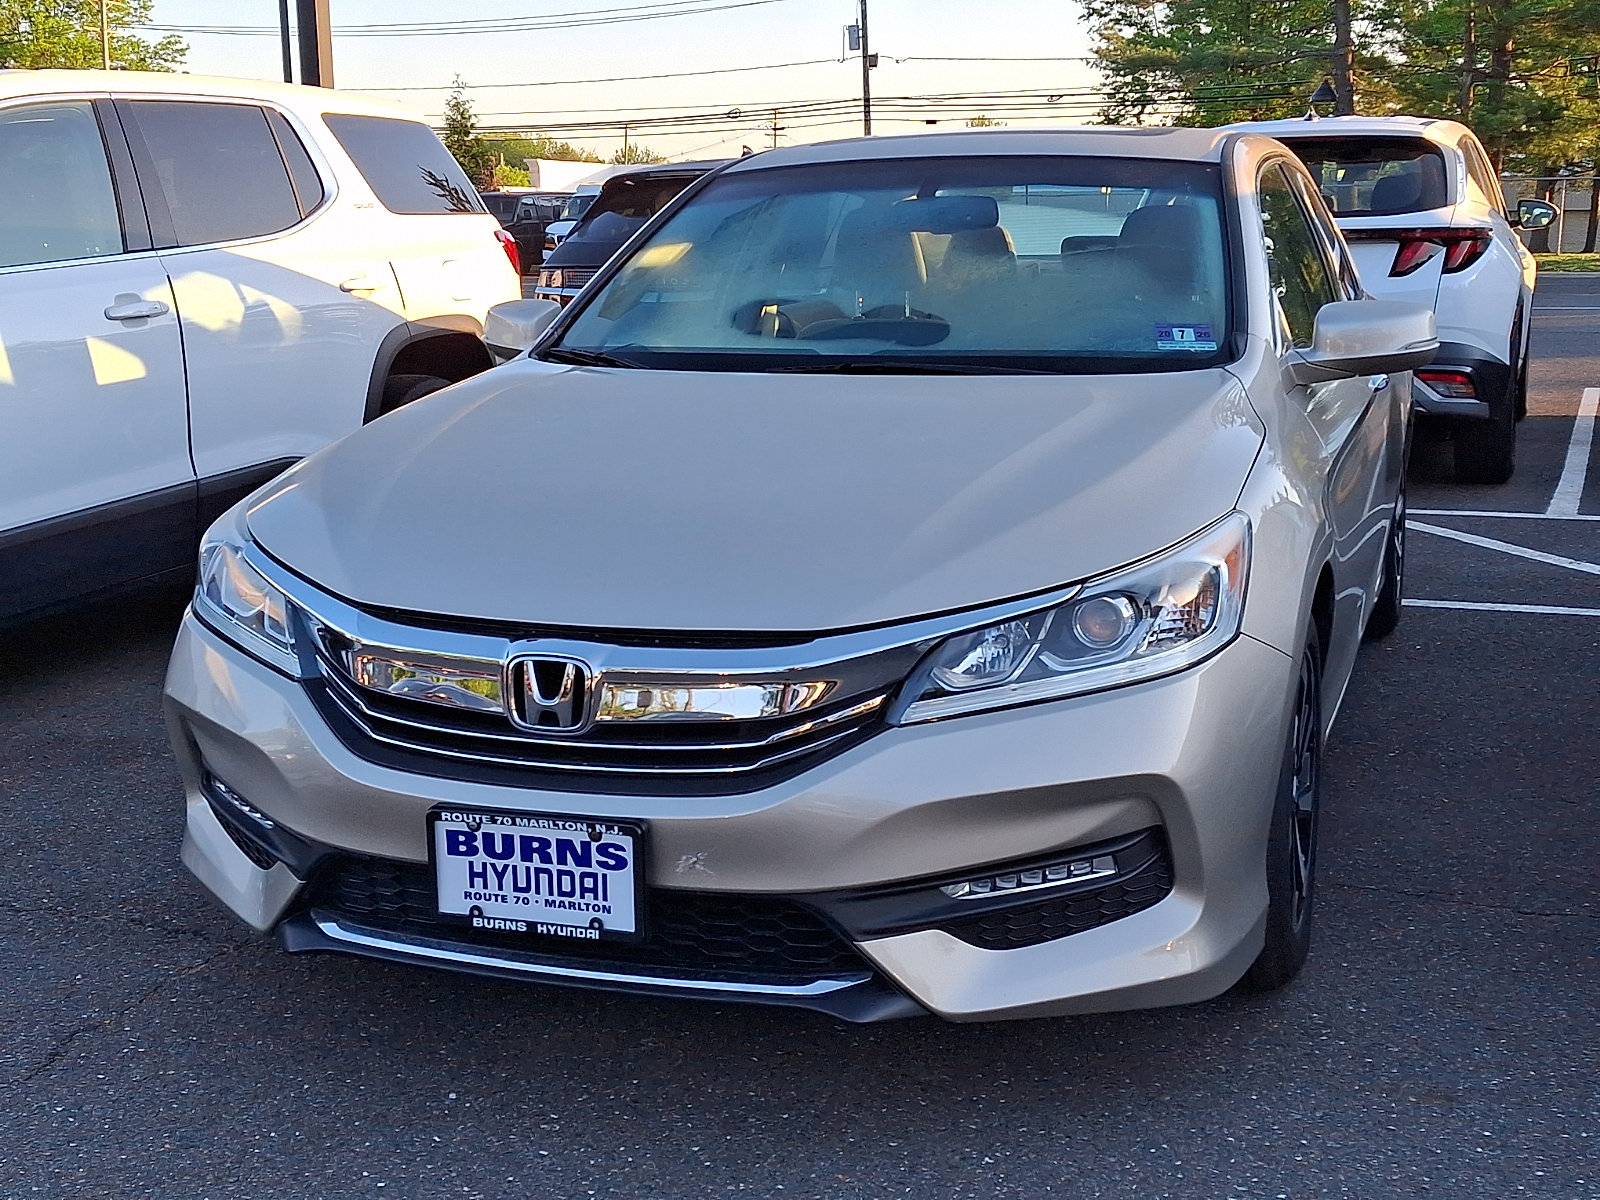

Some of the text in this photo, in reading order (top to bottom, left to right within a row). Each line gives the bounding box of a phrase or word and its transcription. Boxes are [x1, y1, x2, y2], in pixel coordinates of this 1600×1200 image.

[1177, 329, 1186, 340] 7
[441, 812, 492, 825] ROUTE
[494, 816, 512, 826] 70
[595, 823, 623, 836] N.J.
[445, 829, 629, 871] BURNS
[468, 860, 609, 902] HYUNDAI
[463, 890, 612, 915] ROUTE 70 MARLTON
[472, 917, 600, 940] BURNS HYUNDAI
